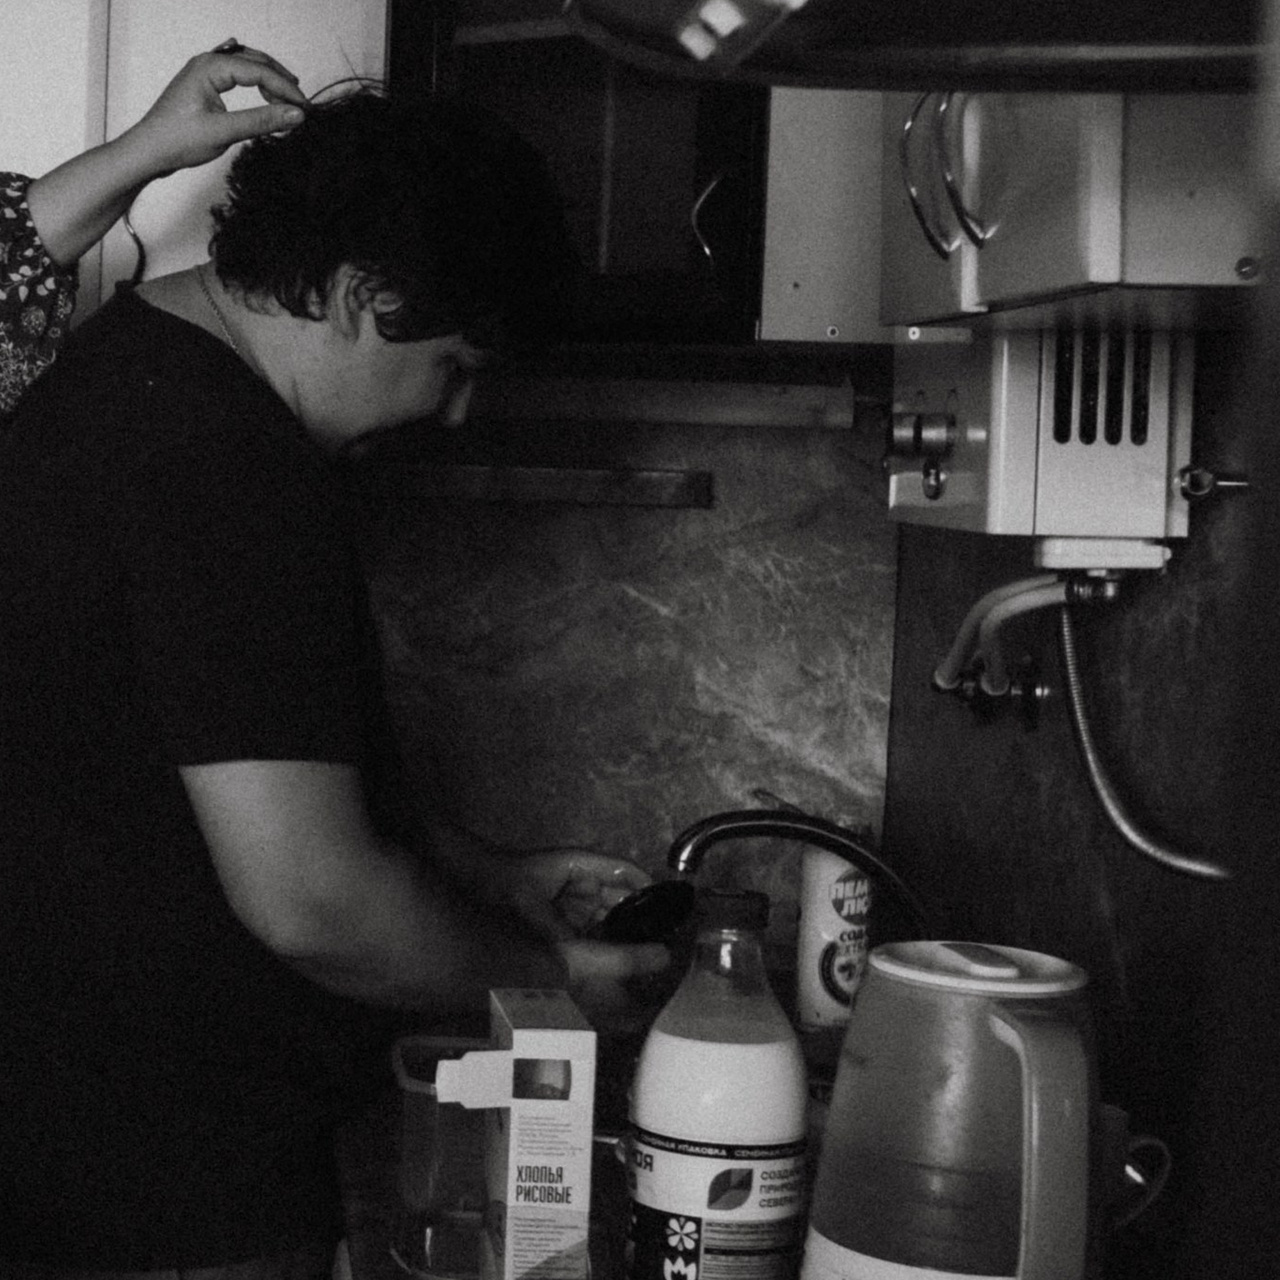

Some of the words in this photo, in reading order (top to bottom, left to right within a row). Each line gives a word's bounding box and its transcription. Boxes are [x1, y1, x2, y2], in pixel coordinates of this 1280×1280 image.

[677, 1142, 727, 1157] УПАКОВКА
[516, 1165, 563, 1184] ХЛОПЬЯ
[516, 1184, 573, 1204] РИСОВЫЕ
